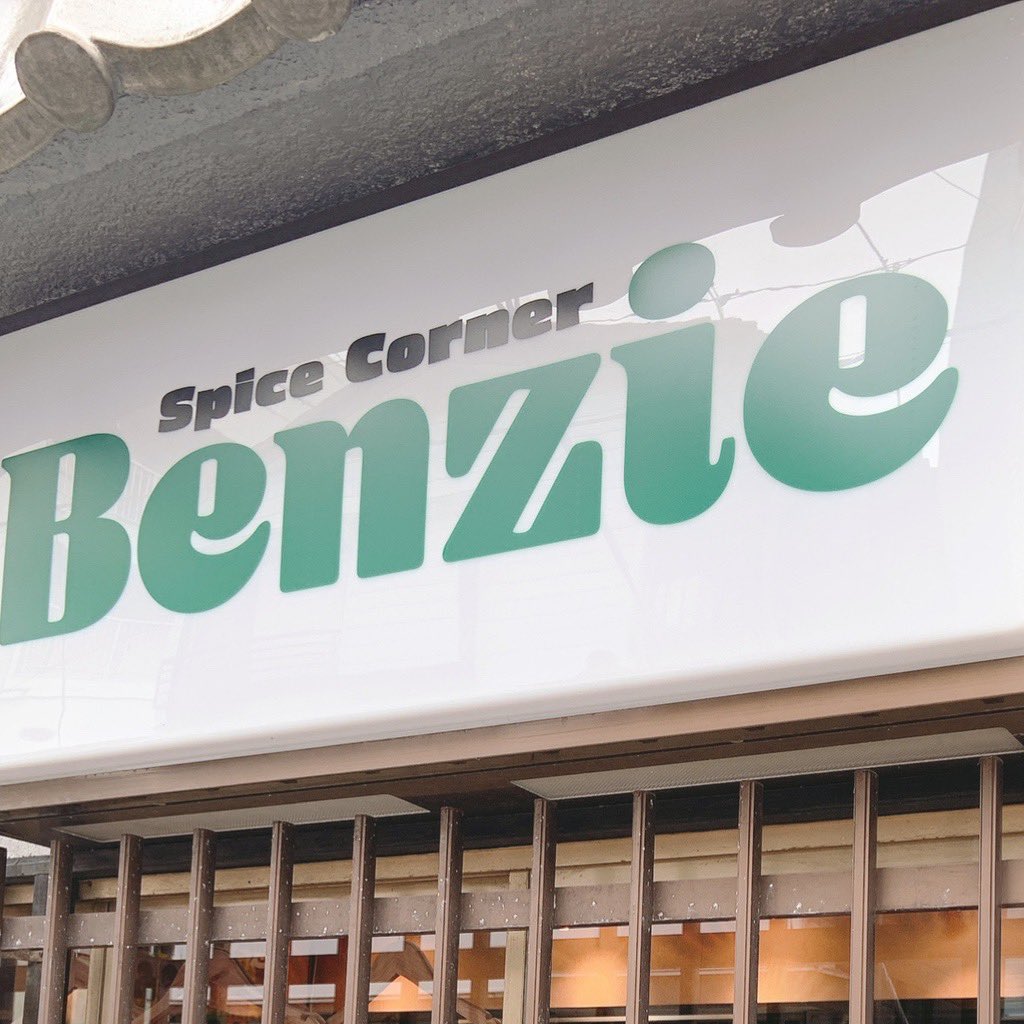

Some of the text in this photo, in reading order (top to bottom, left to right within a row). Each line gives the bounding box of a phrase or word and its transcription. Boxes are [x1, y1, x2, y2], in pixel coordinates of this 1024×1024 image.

[0, 242, 960, 645] Benzie
[157, 281, 594, 432] Spice Corner
